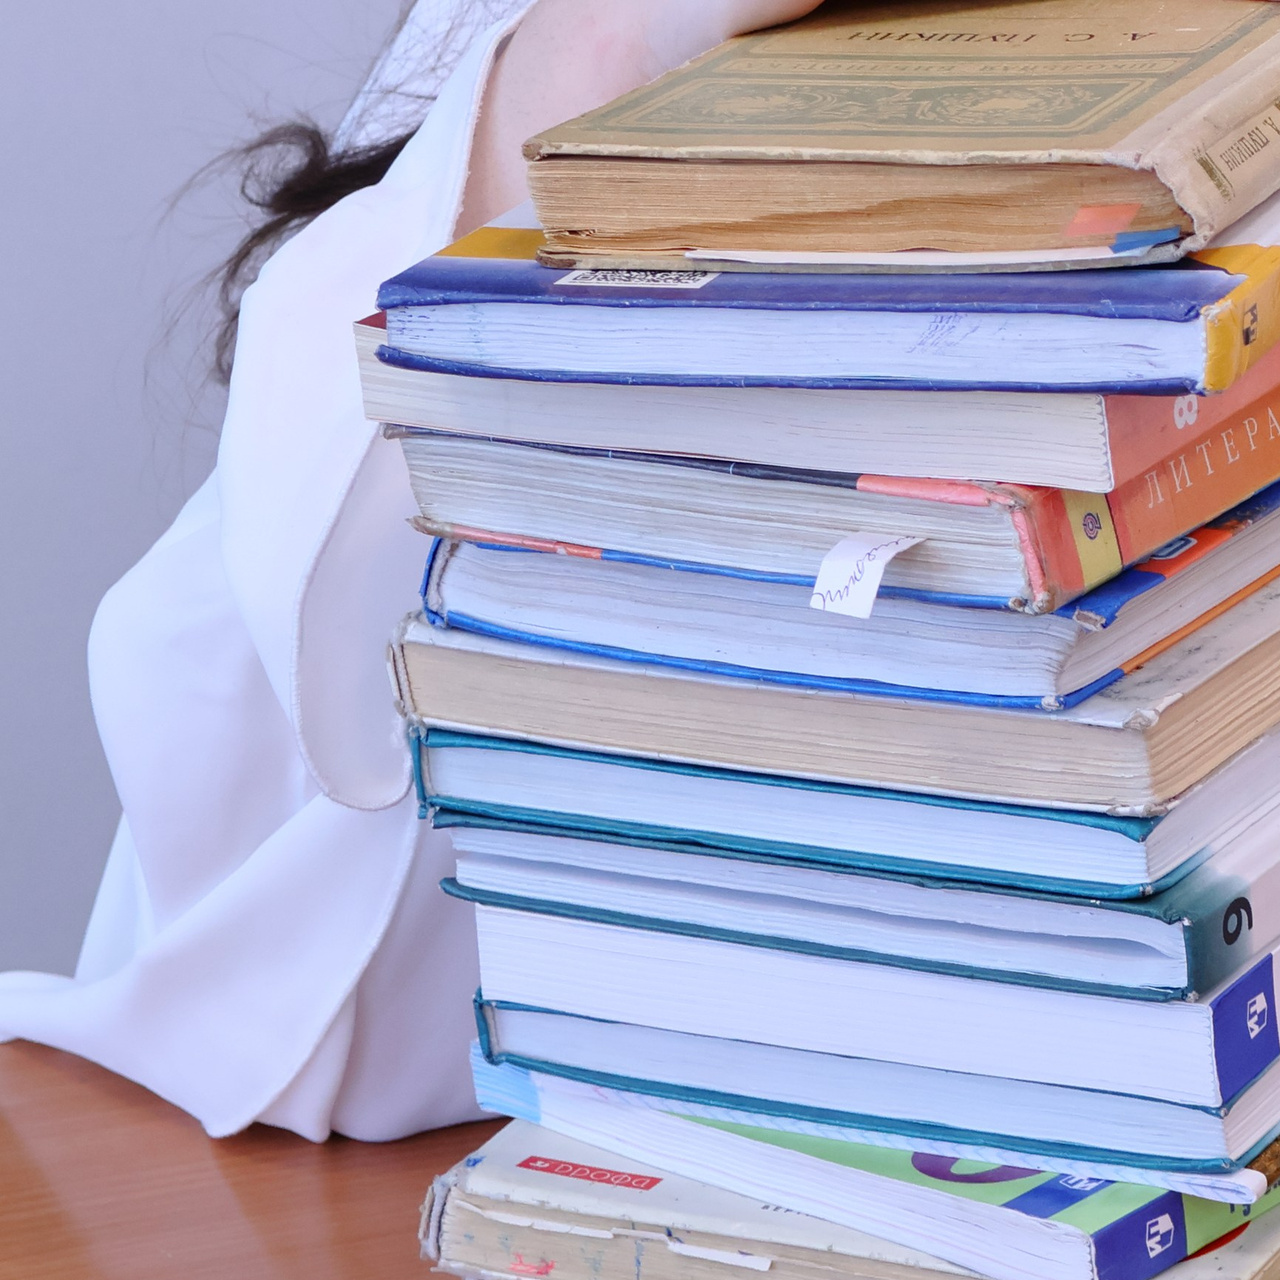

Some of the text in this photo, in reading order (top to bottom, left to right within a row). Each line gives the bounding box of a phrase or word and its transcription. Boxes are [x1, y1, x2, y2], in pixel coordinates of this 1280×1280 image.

[848, 31, 1158, 43] А. С. ПУШКИН
[1219, 116, 1280, 172] А. ПУШКИН
[1173, 394, 1199, 430] 8
